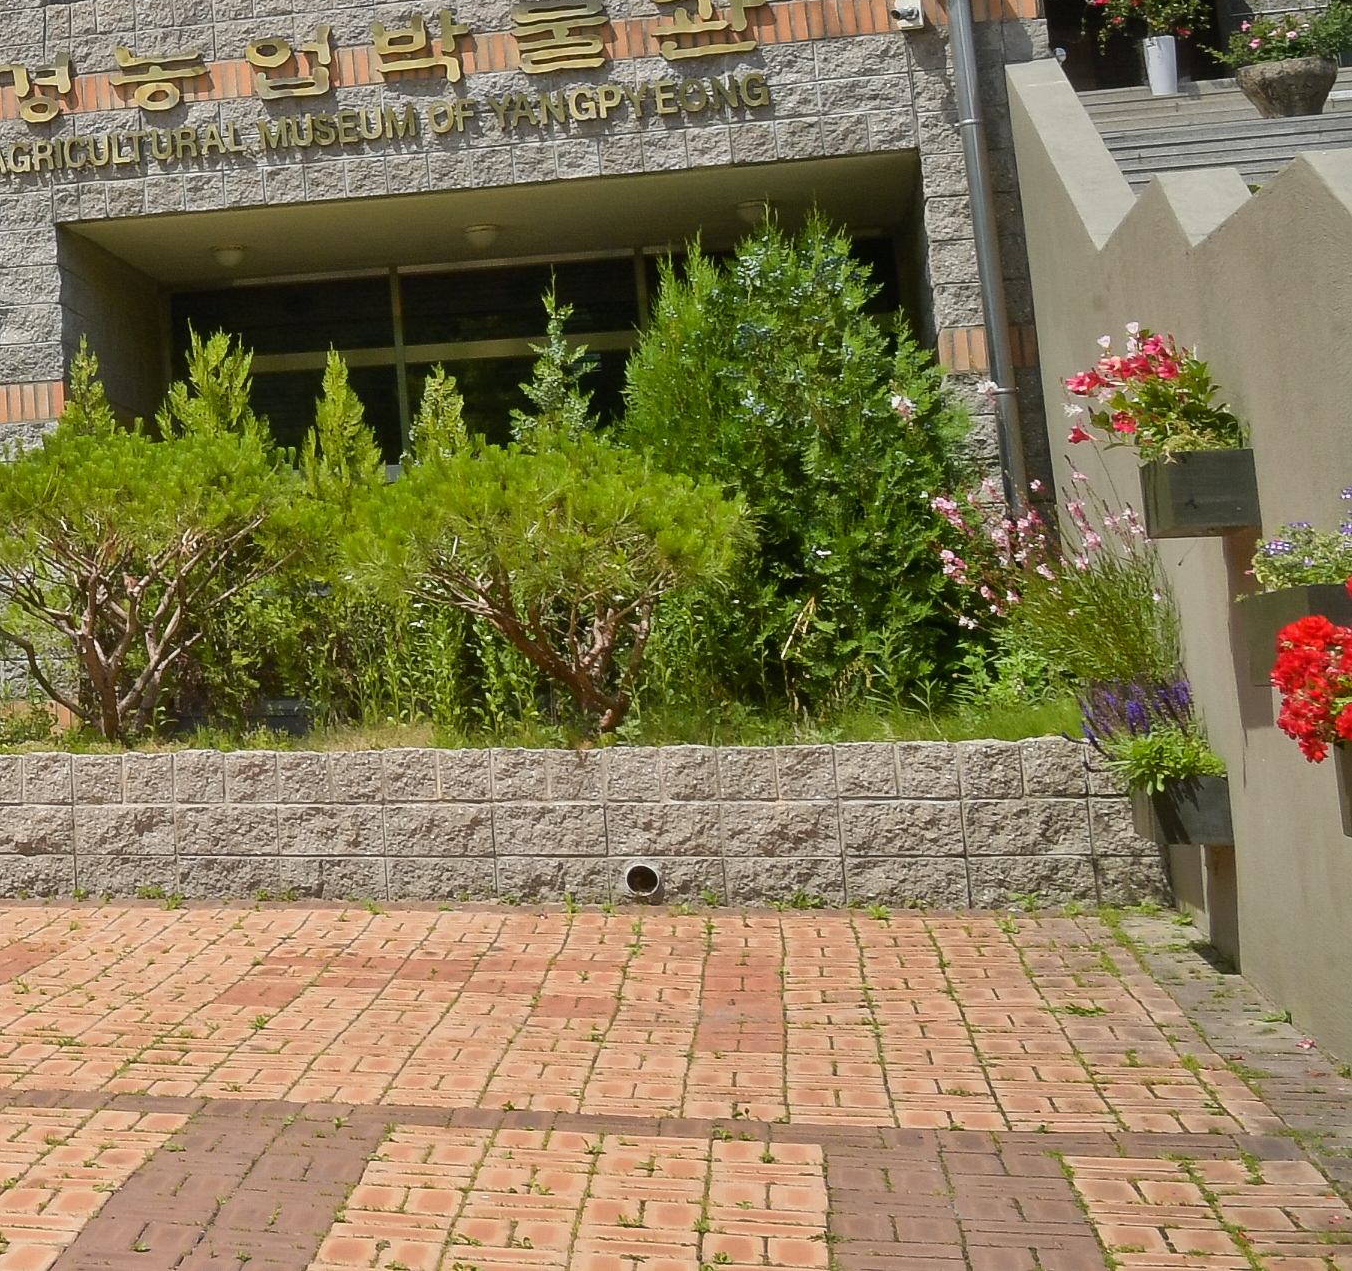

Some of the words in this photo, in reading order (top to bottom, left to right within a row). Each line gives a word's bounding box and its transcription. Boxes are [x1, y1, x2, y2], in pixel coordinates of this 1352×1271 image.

[259, 102, 416, 150] MUSEUM
[428, 98, 476, 134] OF
[493, 72, 770, 130] YANGPYEONG
